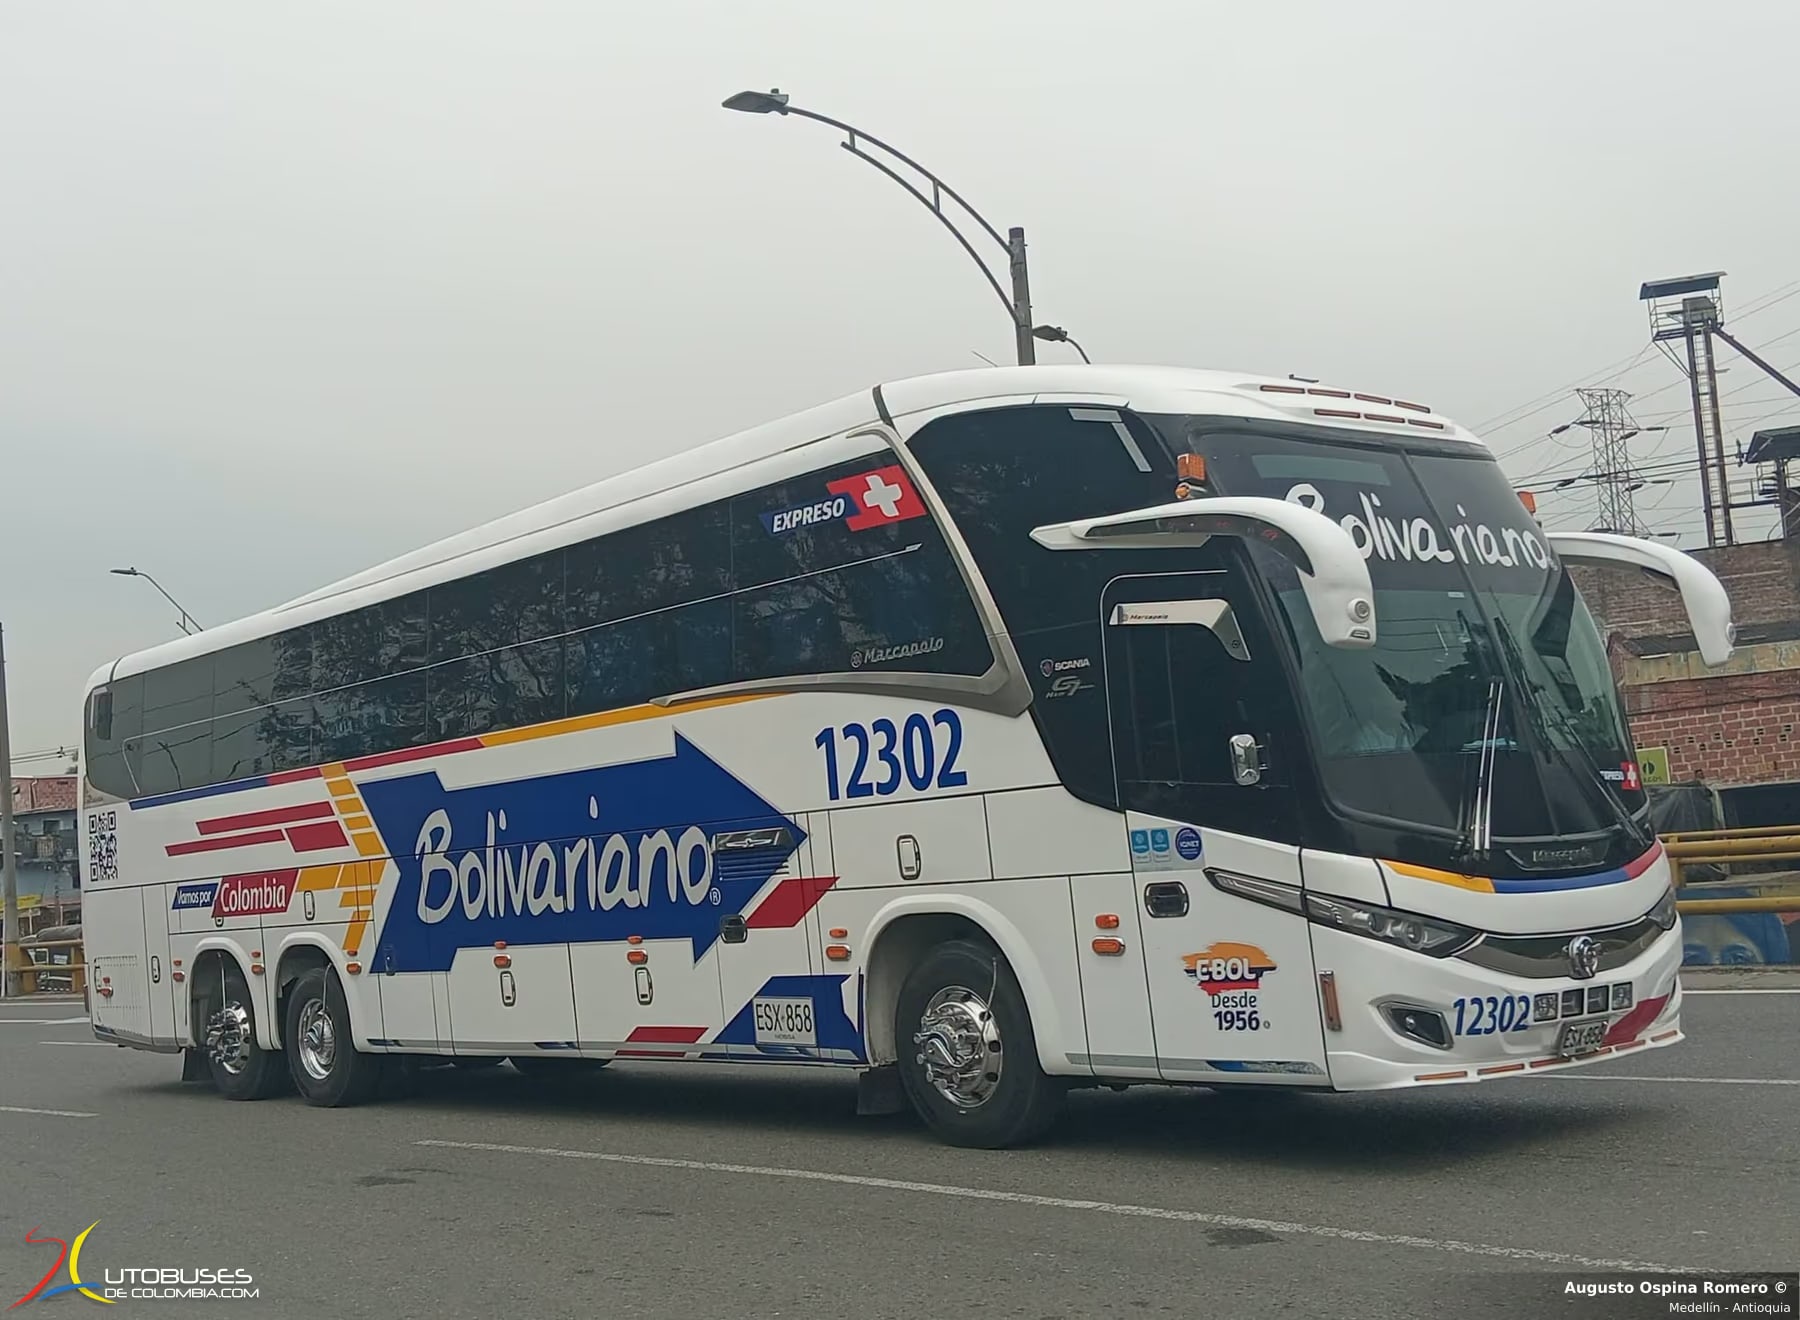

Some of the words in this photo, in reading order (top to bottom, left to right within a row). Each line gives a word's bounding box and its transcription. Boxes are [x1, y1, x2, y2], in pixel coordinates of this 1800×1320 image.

[772, 498, 846, 533] EXPRESO
[864, 637, 944, 663] Marcopolo
[1054, 658, 1091, 671] SCANIA
[815, 708, 968, 800] 12302
[415, 795, 713, 924] Bolivariano
[177, 890, 199, 905] Vamos
[199, 889, 212, 907] por
[220, 877, 287, 913] Colombia
[1212, 991, 1257, 1009] Desde
[1453, 995, 1531, 1036] 12302
[1214, 1010, 1261, 1031] 1956
